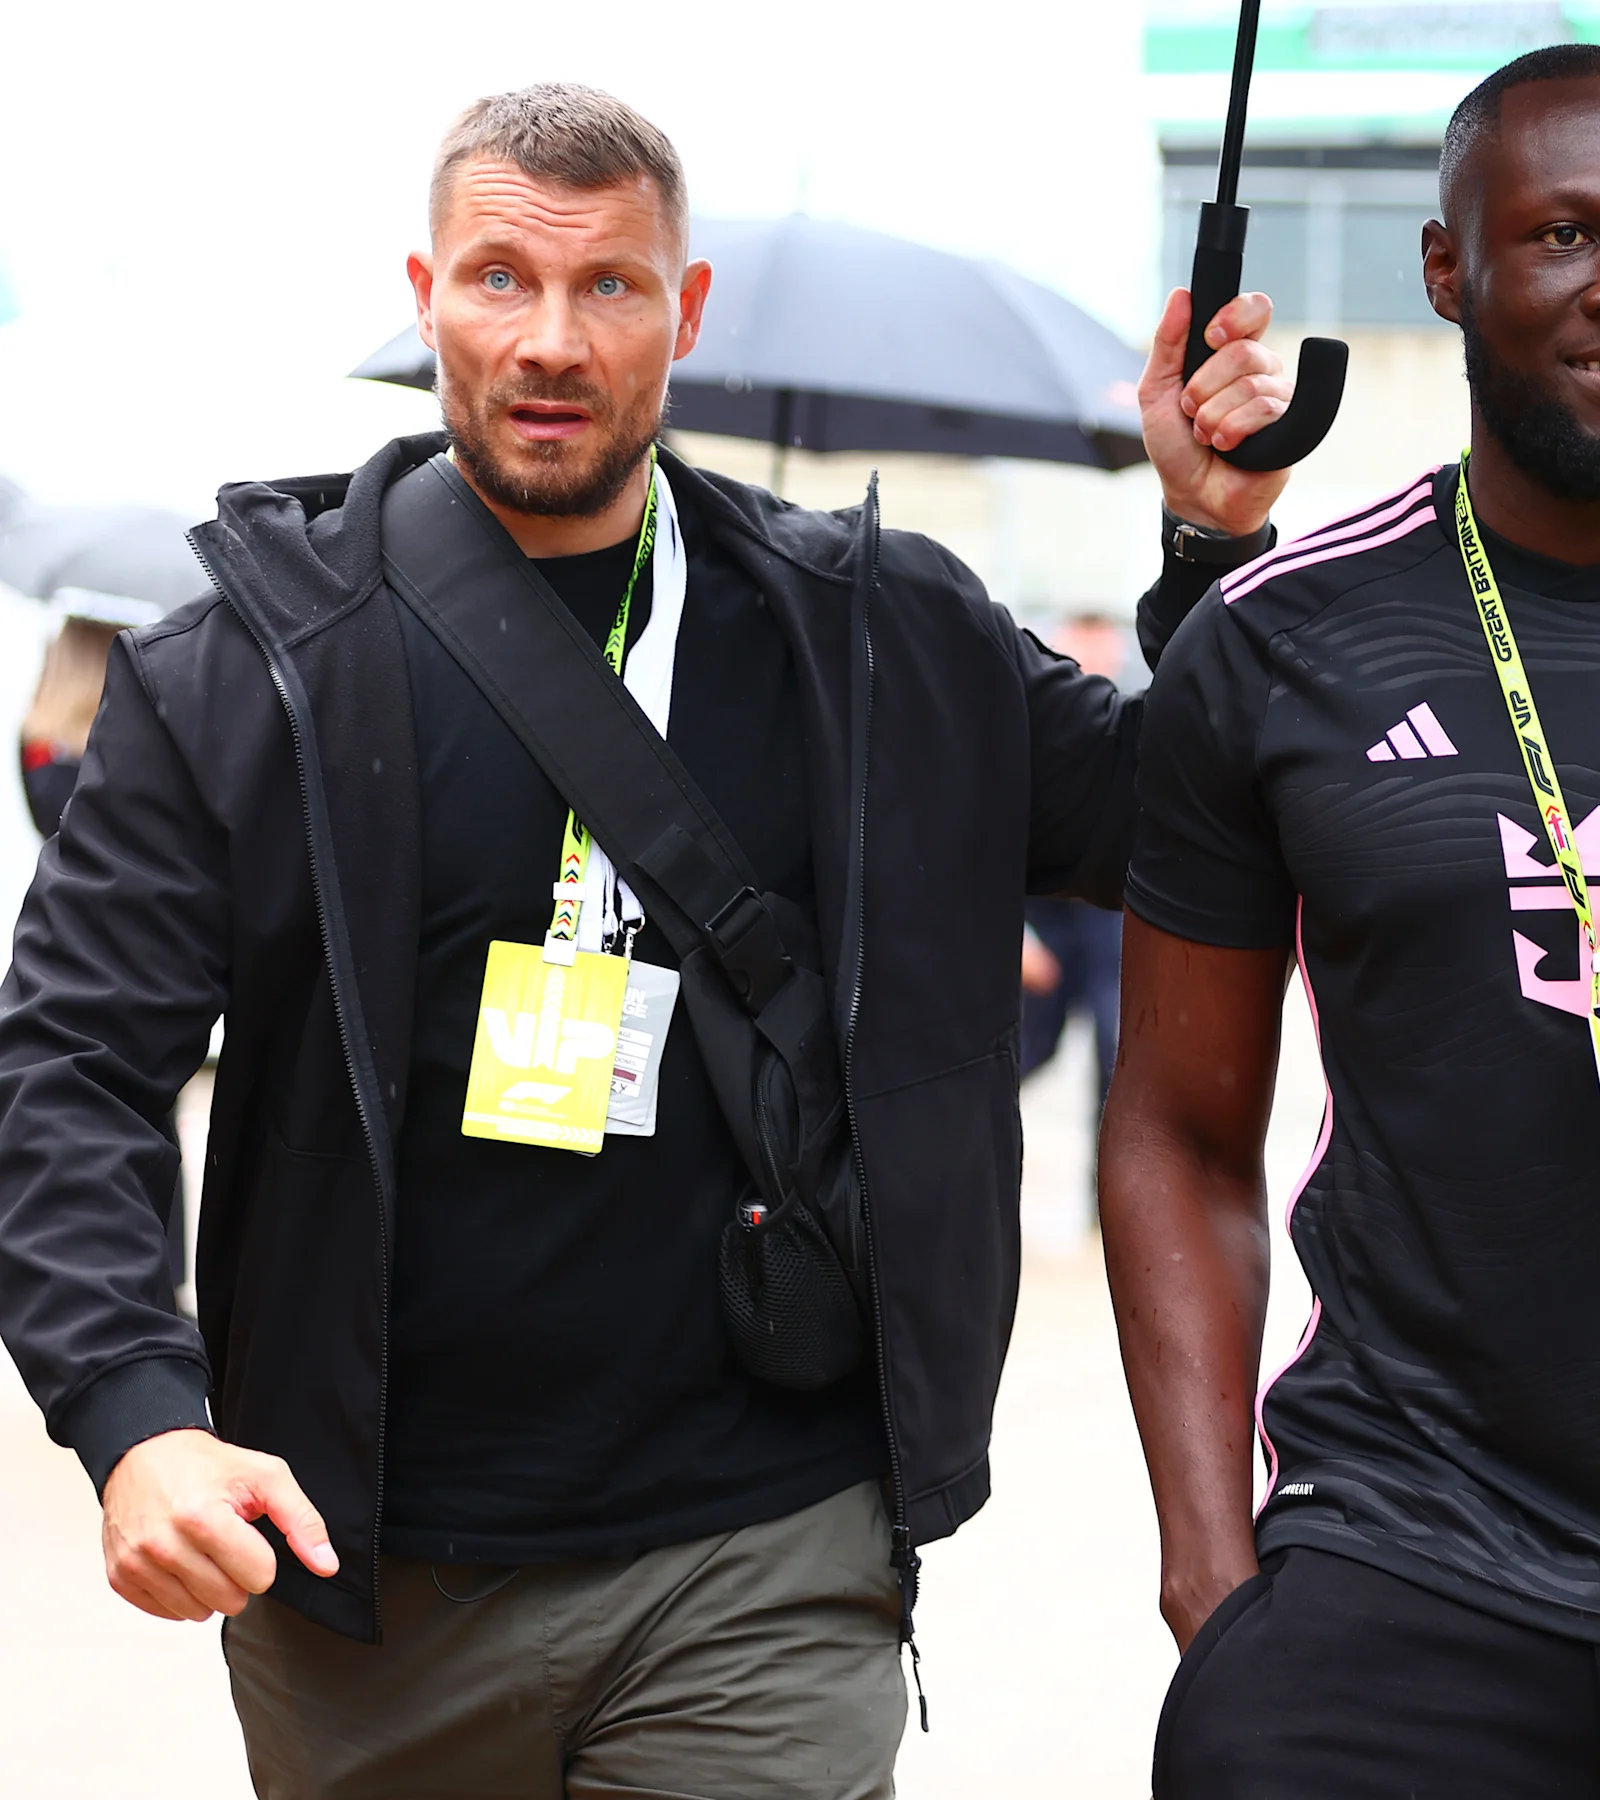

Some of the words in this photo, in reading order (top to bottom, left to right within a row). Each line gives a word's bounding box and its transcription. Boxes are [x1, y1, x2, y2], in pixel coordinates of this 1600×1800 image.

[1480, 599, 1512, 662] GREAT
[1509, 690, 1531, 729] VIP
[622, 1000, 648, 1019] GE
[625, 986, 646, 1004] IN
[481, 1007, 615, 1075] VIP
